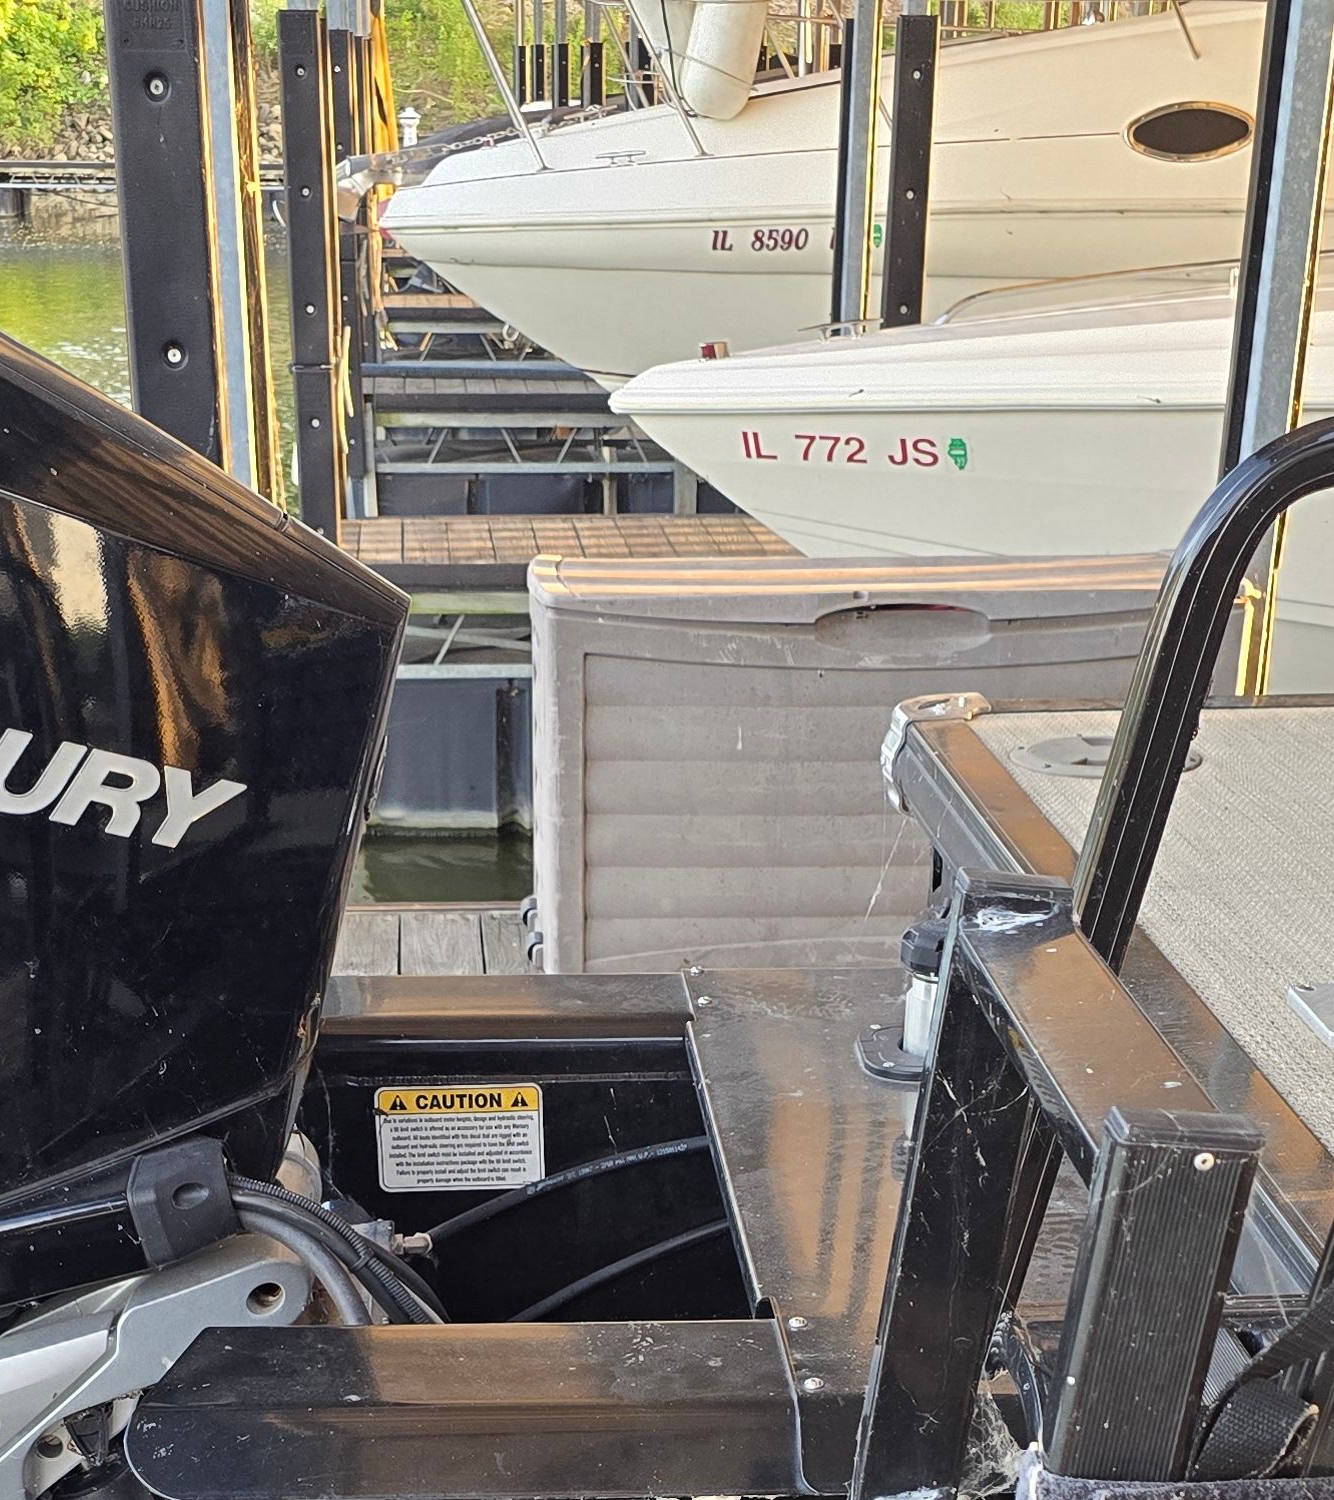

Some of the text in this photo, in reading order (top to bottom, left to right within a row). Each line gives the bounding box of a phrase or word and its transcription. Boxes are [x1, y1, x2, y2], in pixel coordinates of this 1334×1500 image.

[711, 230, 734, 252] IL
[750, 227, 809, 252] 8590
[741, 431, 778, 460] IL
[794, 434, 868, 464] 772
[887, 438, 940, 467] JS
[415, 1093, 503, 1110] CAUTION
